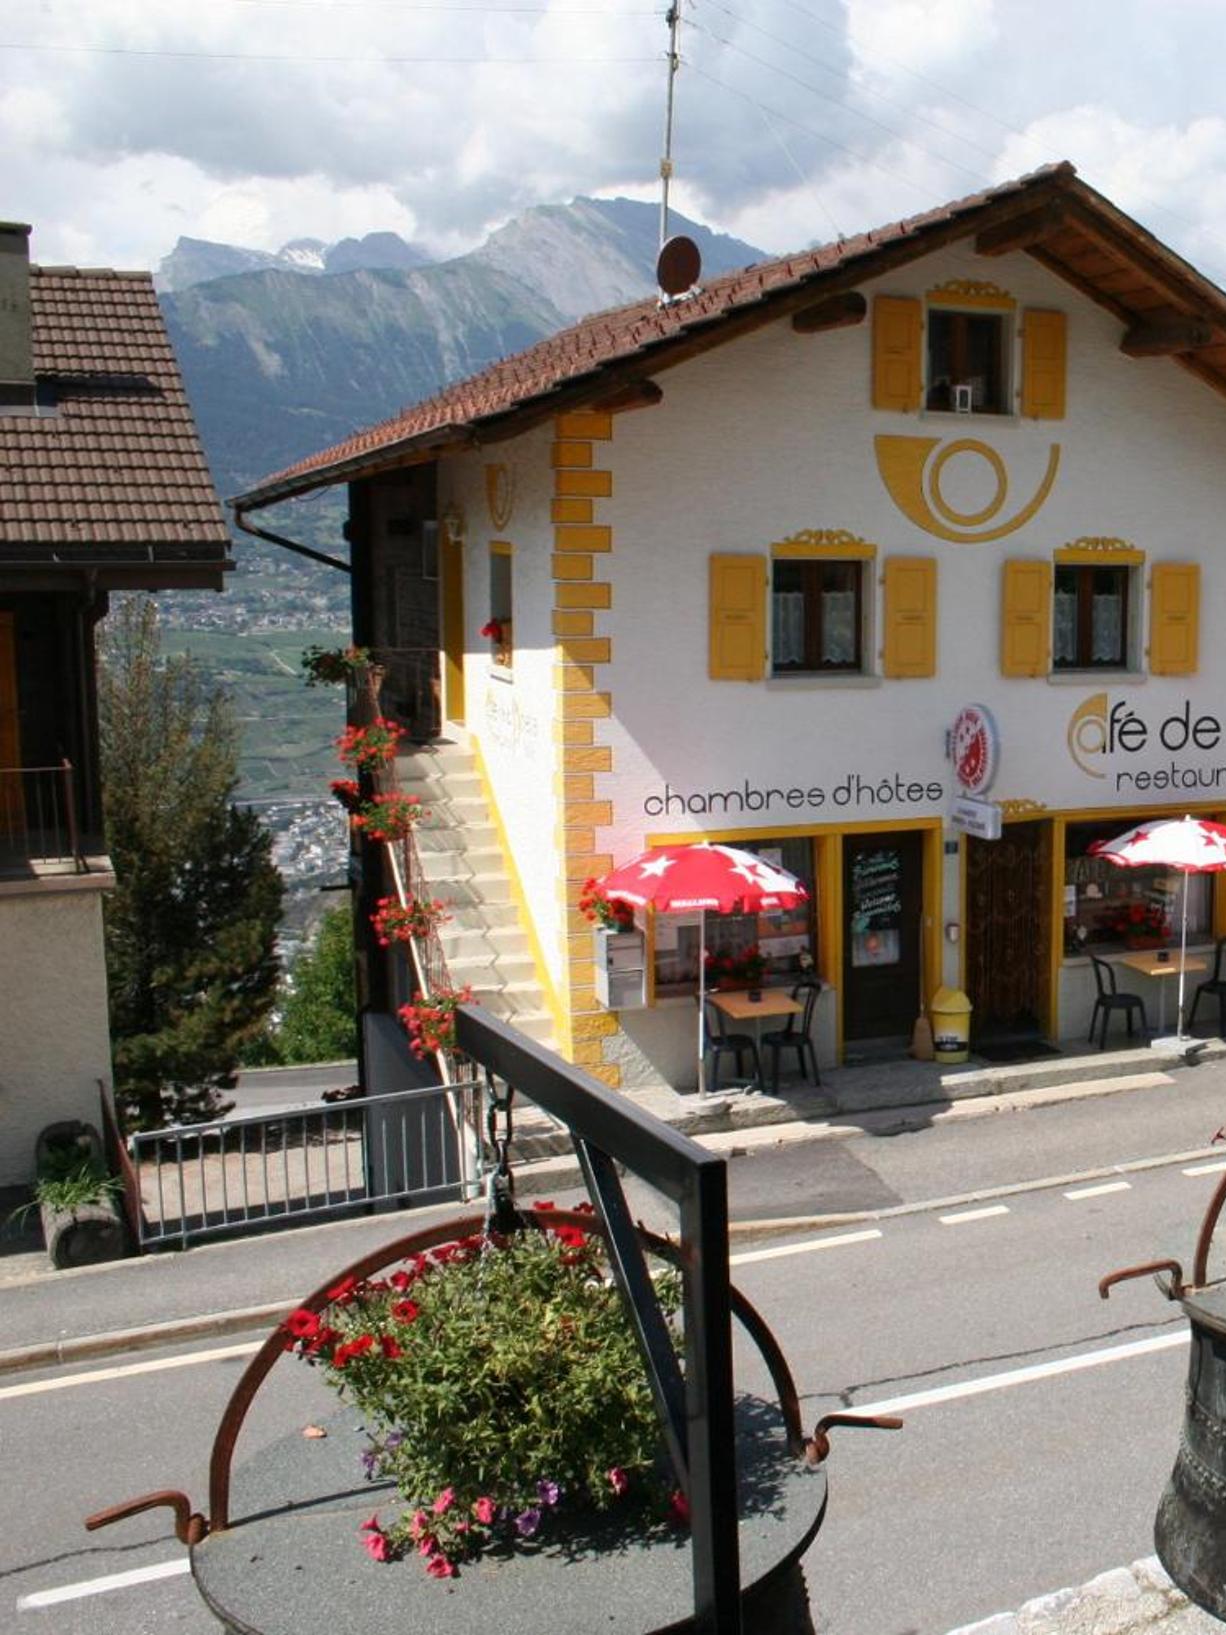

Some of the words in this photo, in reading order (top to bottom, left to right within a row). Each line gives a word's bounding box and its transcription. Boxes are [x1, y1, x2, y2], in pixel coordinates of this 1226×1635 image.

[1160, 700, 1221, 751] de
[644, 780, 825, 816] chambres
[833, 773, 943, 806] d'hôtes
